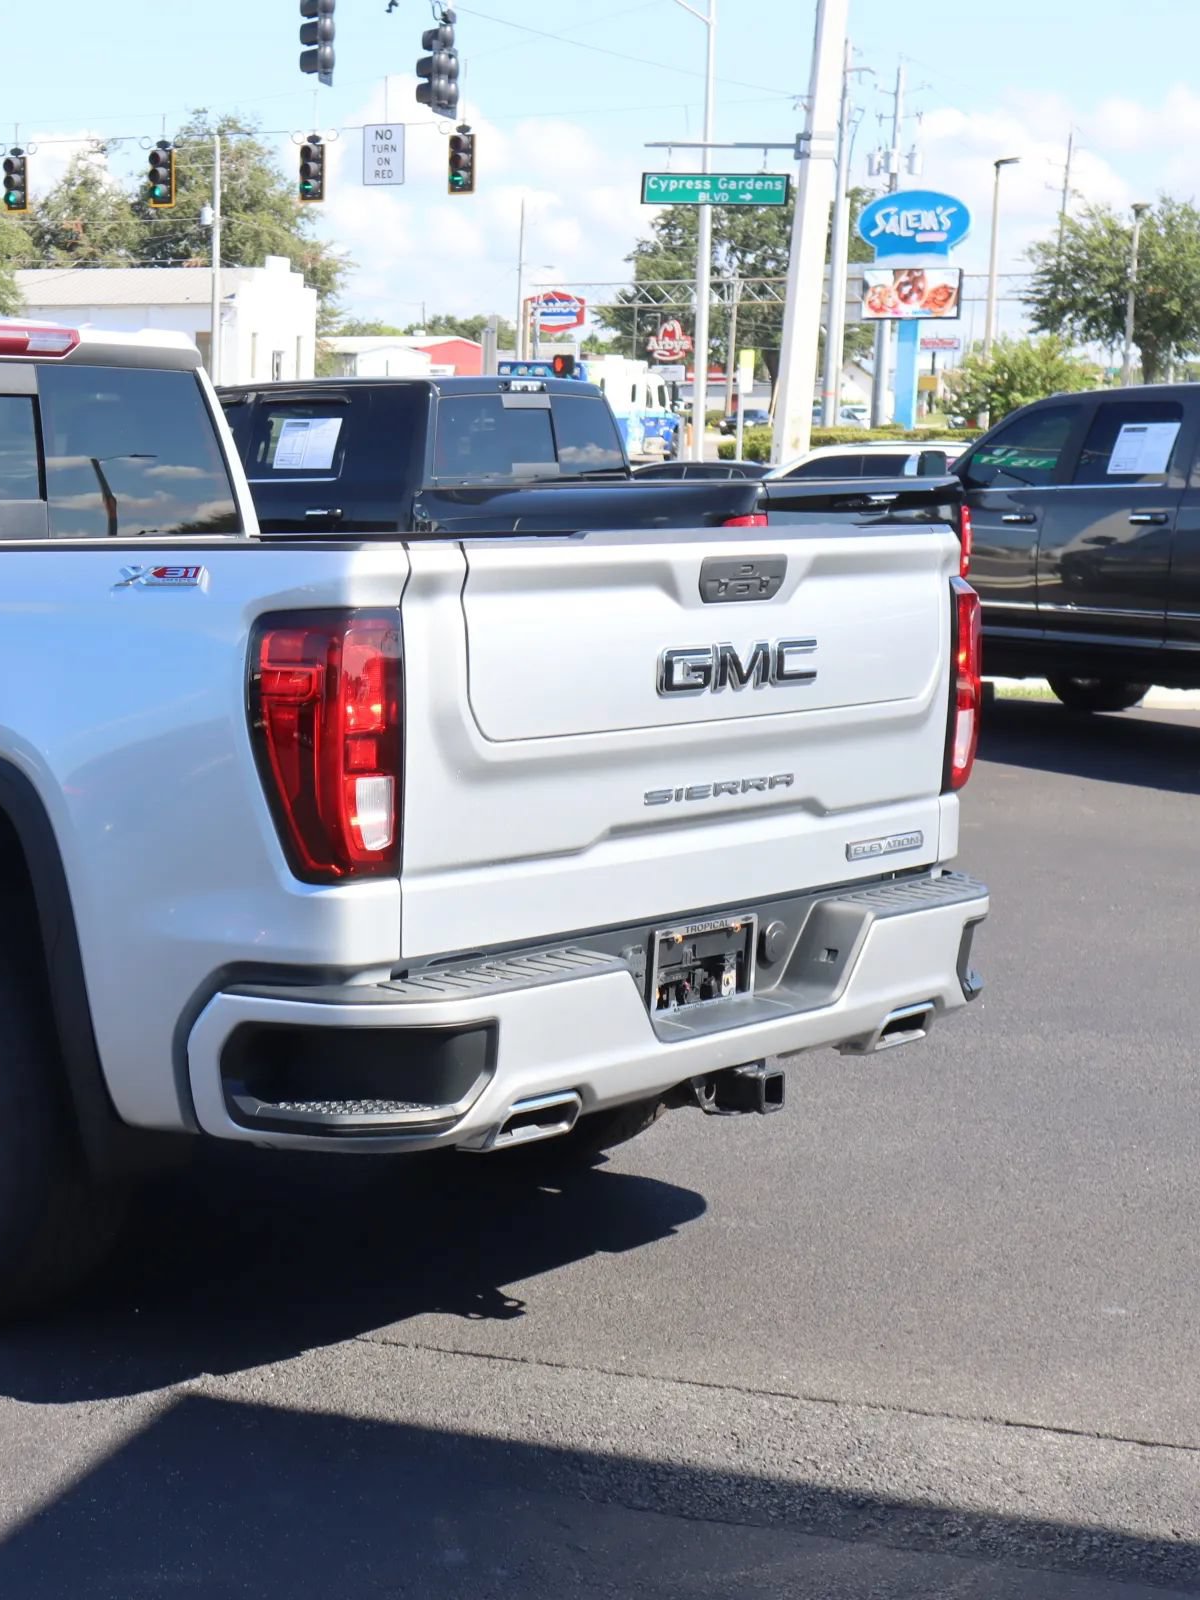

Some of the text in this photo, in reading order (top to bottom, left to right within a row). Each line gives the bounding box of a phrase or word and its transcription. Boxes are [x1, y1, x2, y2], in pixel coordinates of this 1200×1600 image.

[375, 129, 393, 141] NO
[371, 144, 398, 154] TURN
[376, 156, 391, 167] ON
[374, 169, 394, 179] RED
[648, 177, 783, 192] Cypress Gardens
[698, 191, 730, 202] BLVD
[869, 206, 958, 237] SALEM'S
[657, 636, 818, 698] GMC
[643, 773, 795, 806] SIERRA
[853, 836, 920, 855] ELEVATION
[685, 920, 730, 933] TROPICAL
